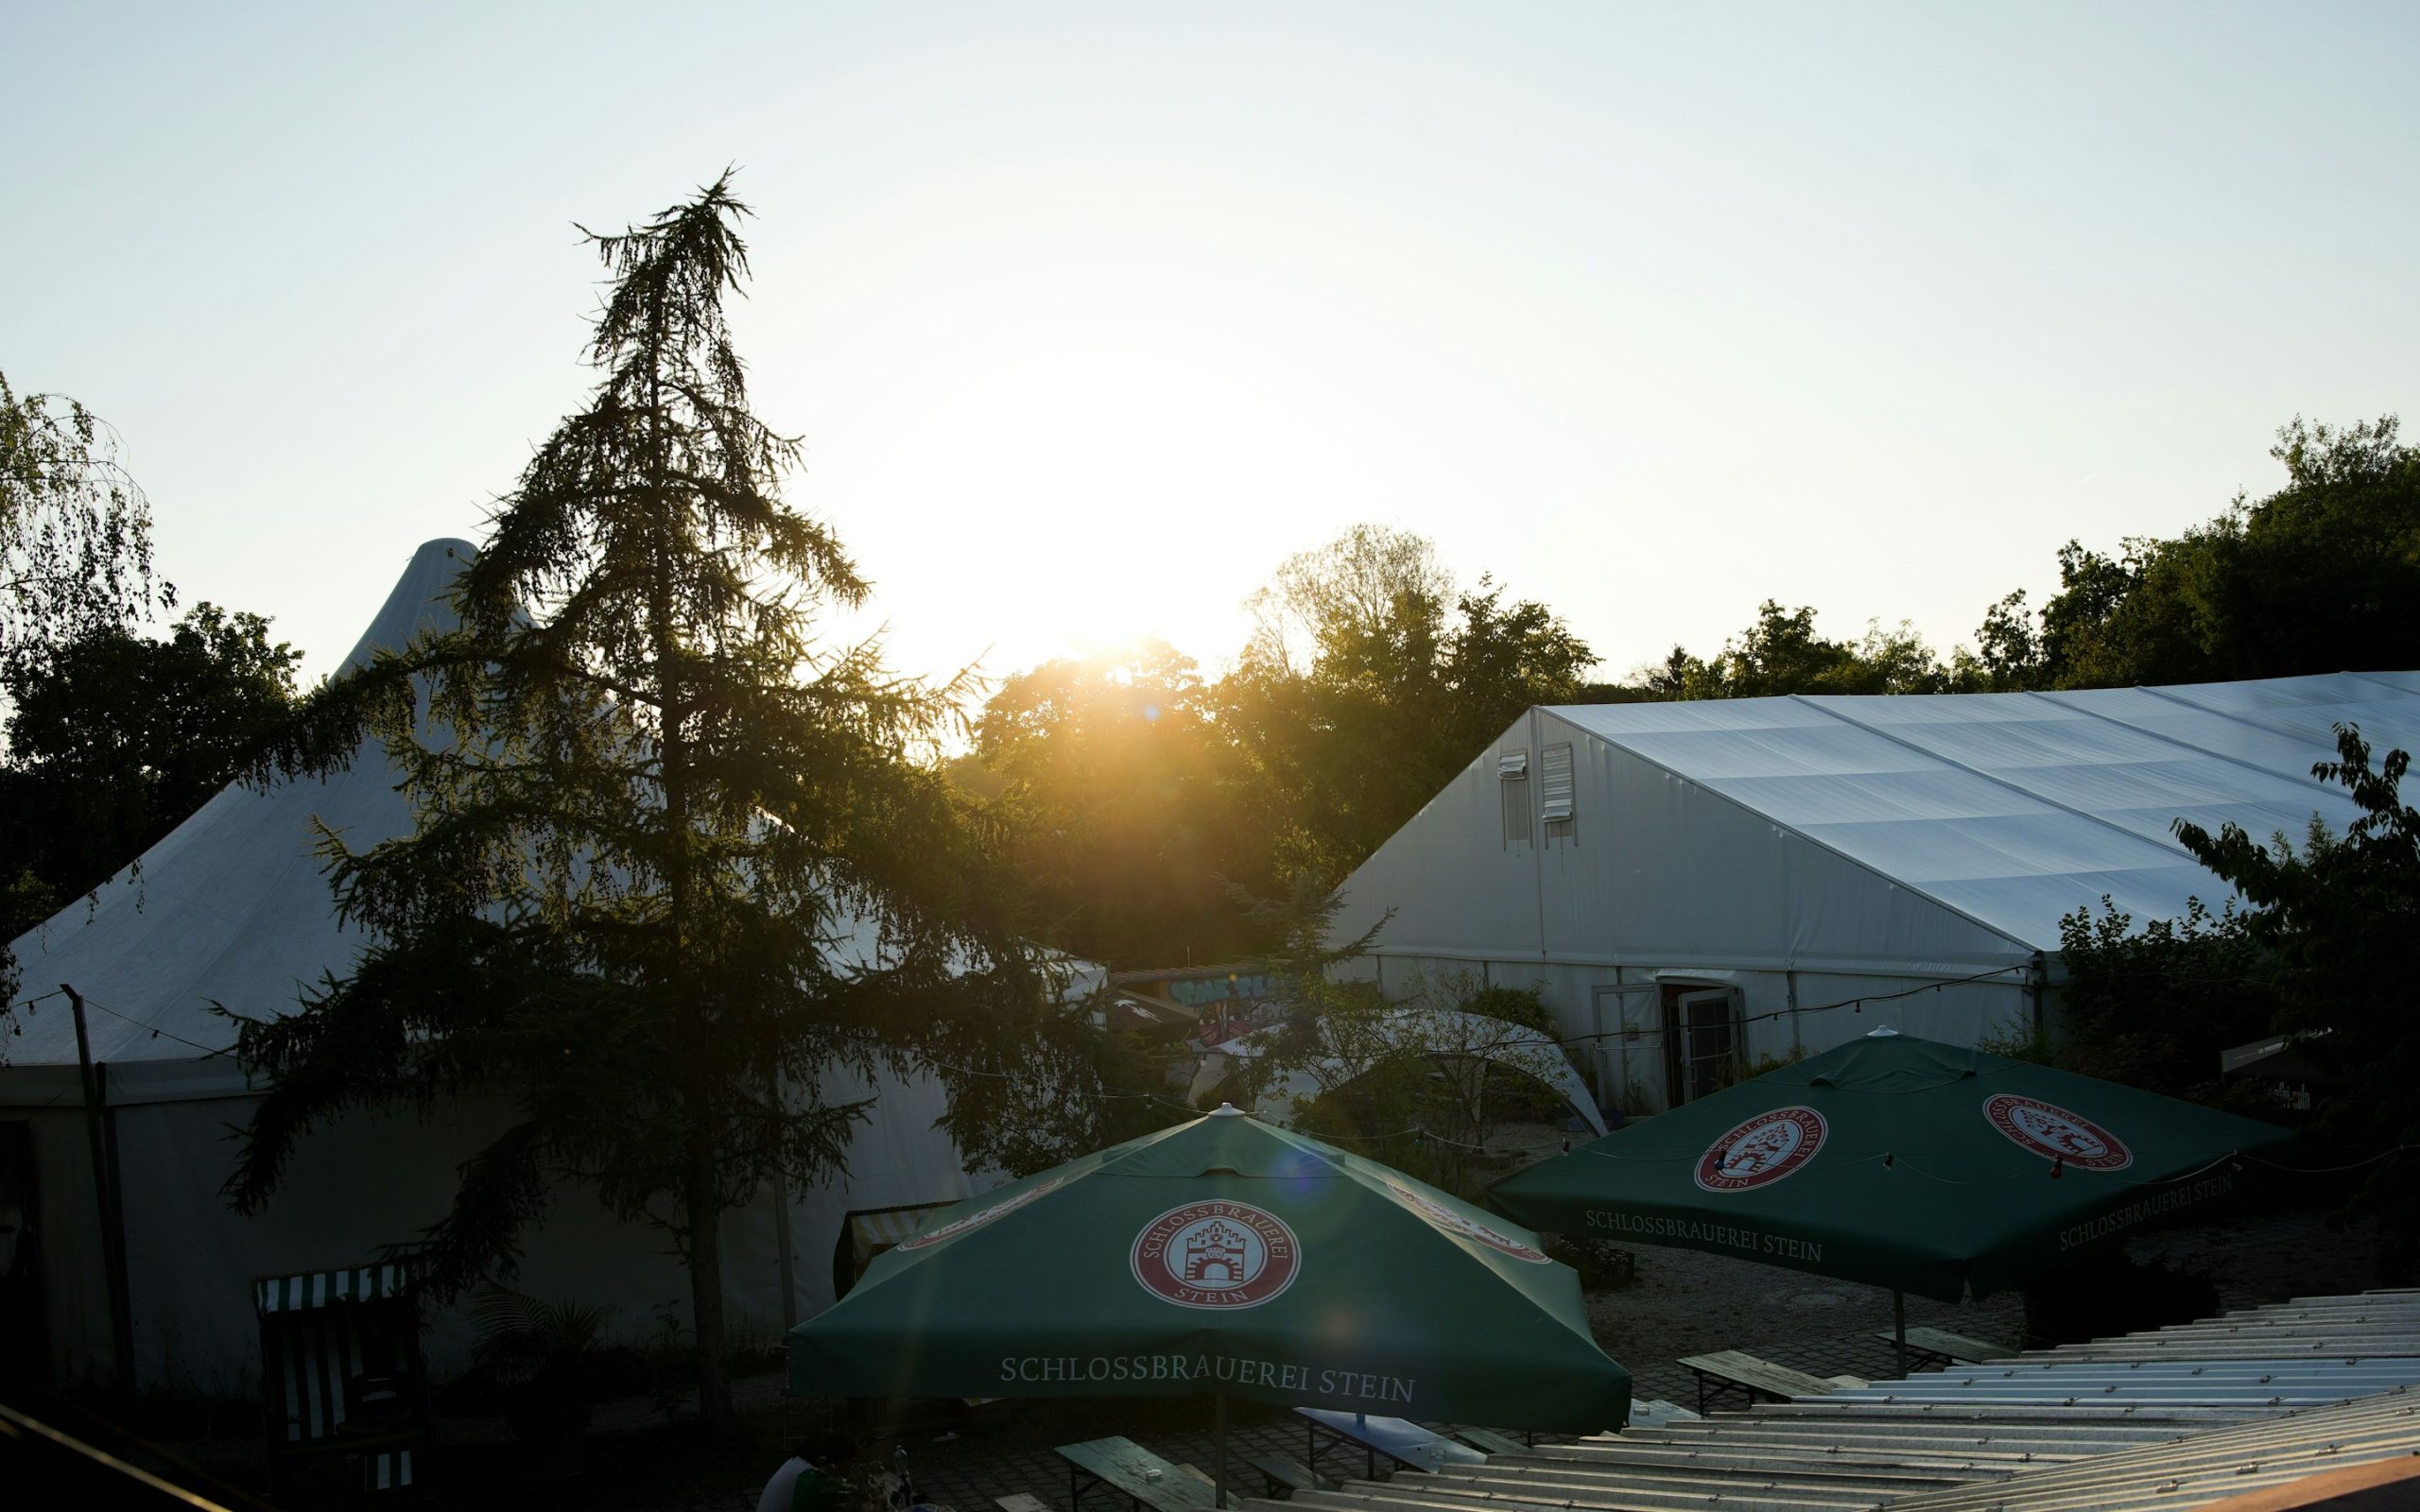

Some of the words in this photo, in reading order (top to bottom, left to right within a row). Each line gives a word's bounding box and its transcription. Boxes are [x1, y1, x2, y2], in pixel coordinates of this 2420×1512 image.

[1718, 1109, 1820, 1159] SCHLOSSBRAUEREI
[1992, 1097, 2089, 1145] SCHLOSSBRAUEREI
[1704, 1174, 1750, 1188] STEIN
[2085, 1151, 2124, 1167] STEIN
[1143, 1204, 1288, 1260] SCHLOSSBRAUEREI
[1585, 1210, 1758, 1251] SCHLOSSBRAUEREI
[1762, 1233, 1824, 1263] STEIN
[2059, 1184, 2192, 1252] SCHLOSSBRAUEREI
[2194, 1172, 2233, 1203] STEIN
[1174, 1288, 1249, 1303] STEIN
[999, 1354, 1310, 1391] SCHLOSSBRAUEREI
[1318, 1369, 1416, 1403] STEIN
